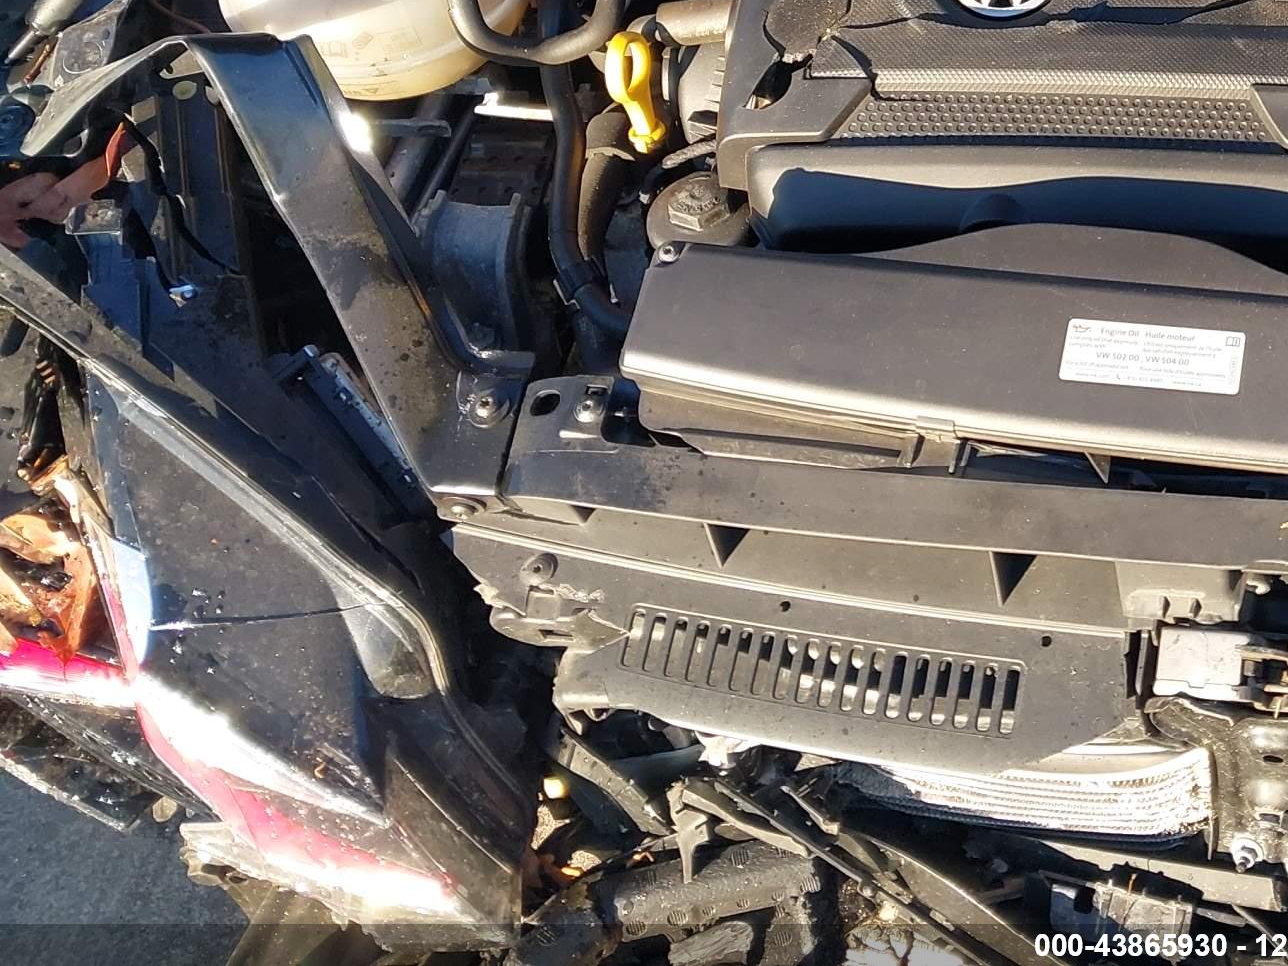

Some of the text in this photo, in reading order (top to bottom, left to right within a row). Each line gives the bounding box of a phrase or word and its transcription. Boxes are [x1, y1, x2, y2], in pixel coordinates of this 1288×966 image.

[1101, 328, 1126, 336] Engine
[1145, 331, 1165, 339] Huile
[1167, 334, 1195, 342] moteur
[1112, 353, 1126, 361] 502
